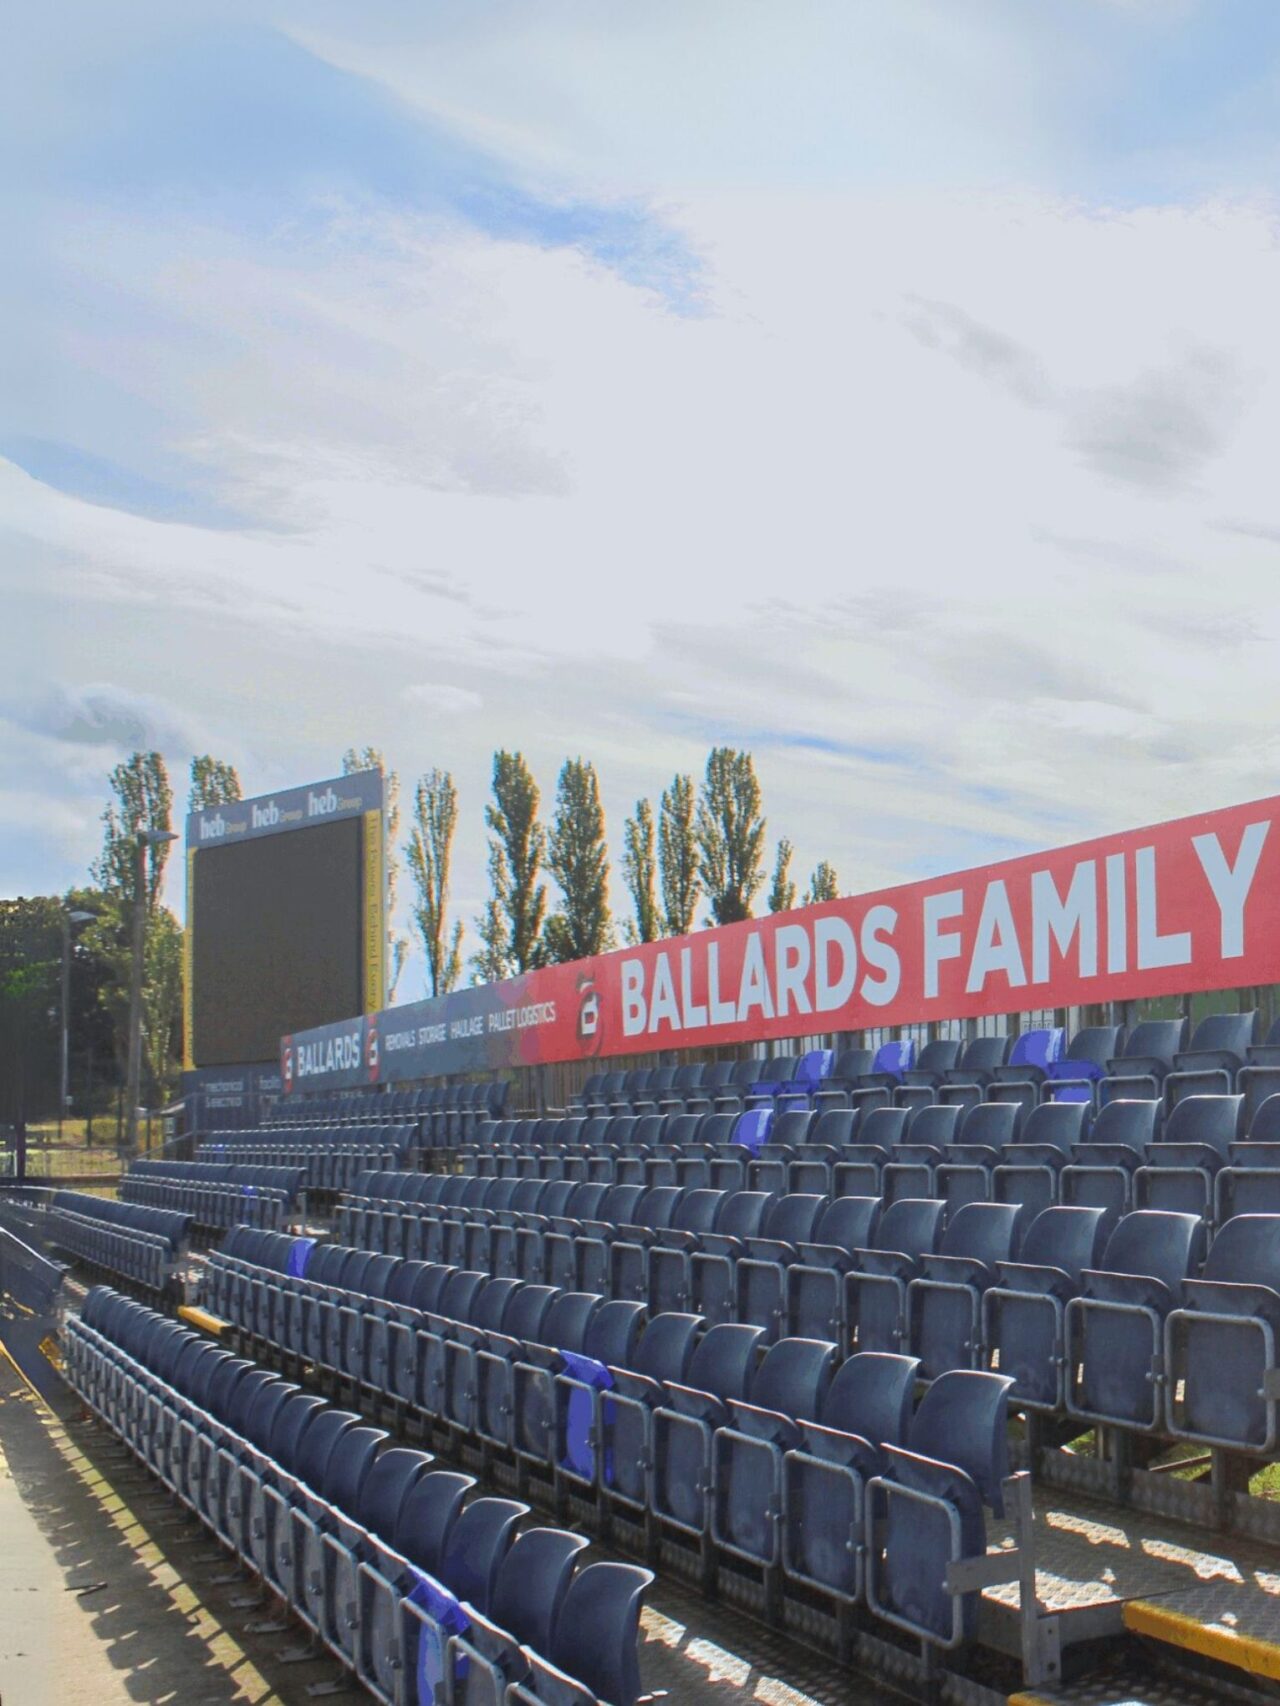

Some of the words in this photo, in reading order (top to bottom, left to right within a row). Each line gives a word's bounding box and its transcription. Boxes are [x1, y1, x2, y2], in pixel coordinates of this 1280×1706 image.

[252, 800, 279, 828] heb
[308, 787, 337, 816] heb
[200, 813, 225, 840] heb
[620, 904, 901, 1036] BALLARDS
[922, 820, 1271, 1000] FAMILY
[488, 1009, 516, 1032] PALLET
[517, 1001, 556, 1028] LOGISTICS
[297, 1032, 360, 1077] BALLARDS
